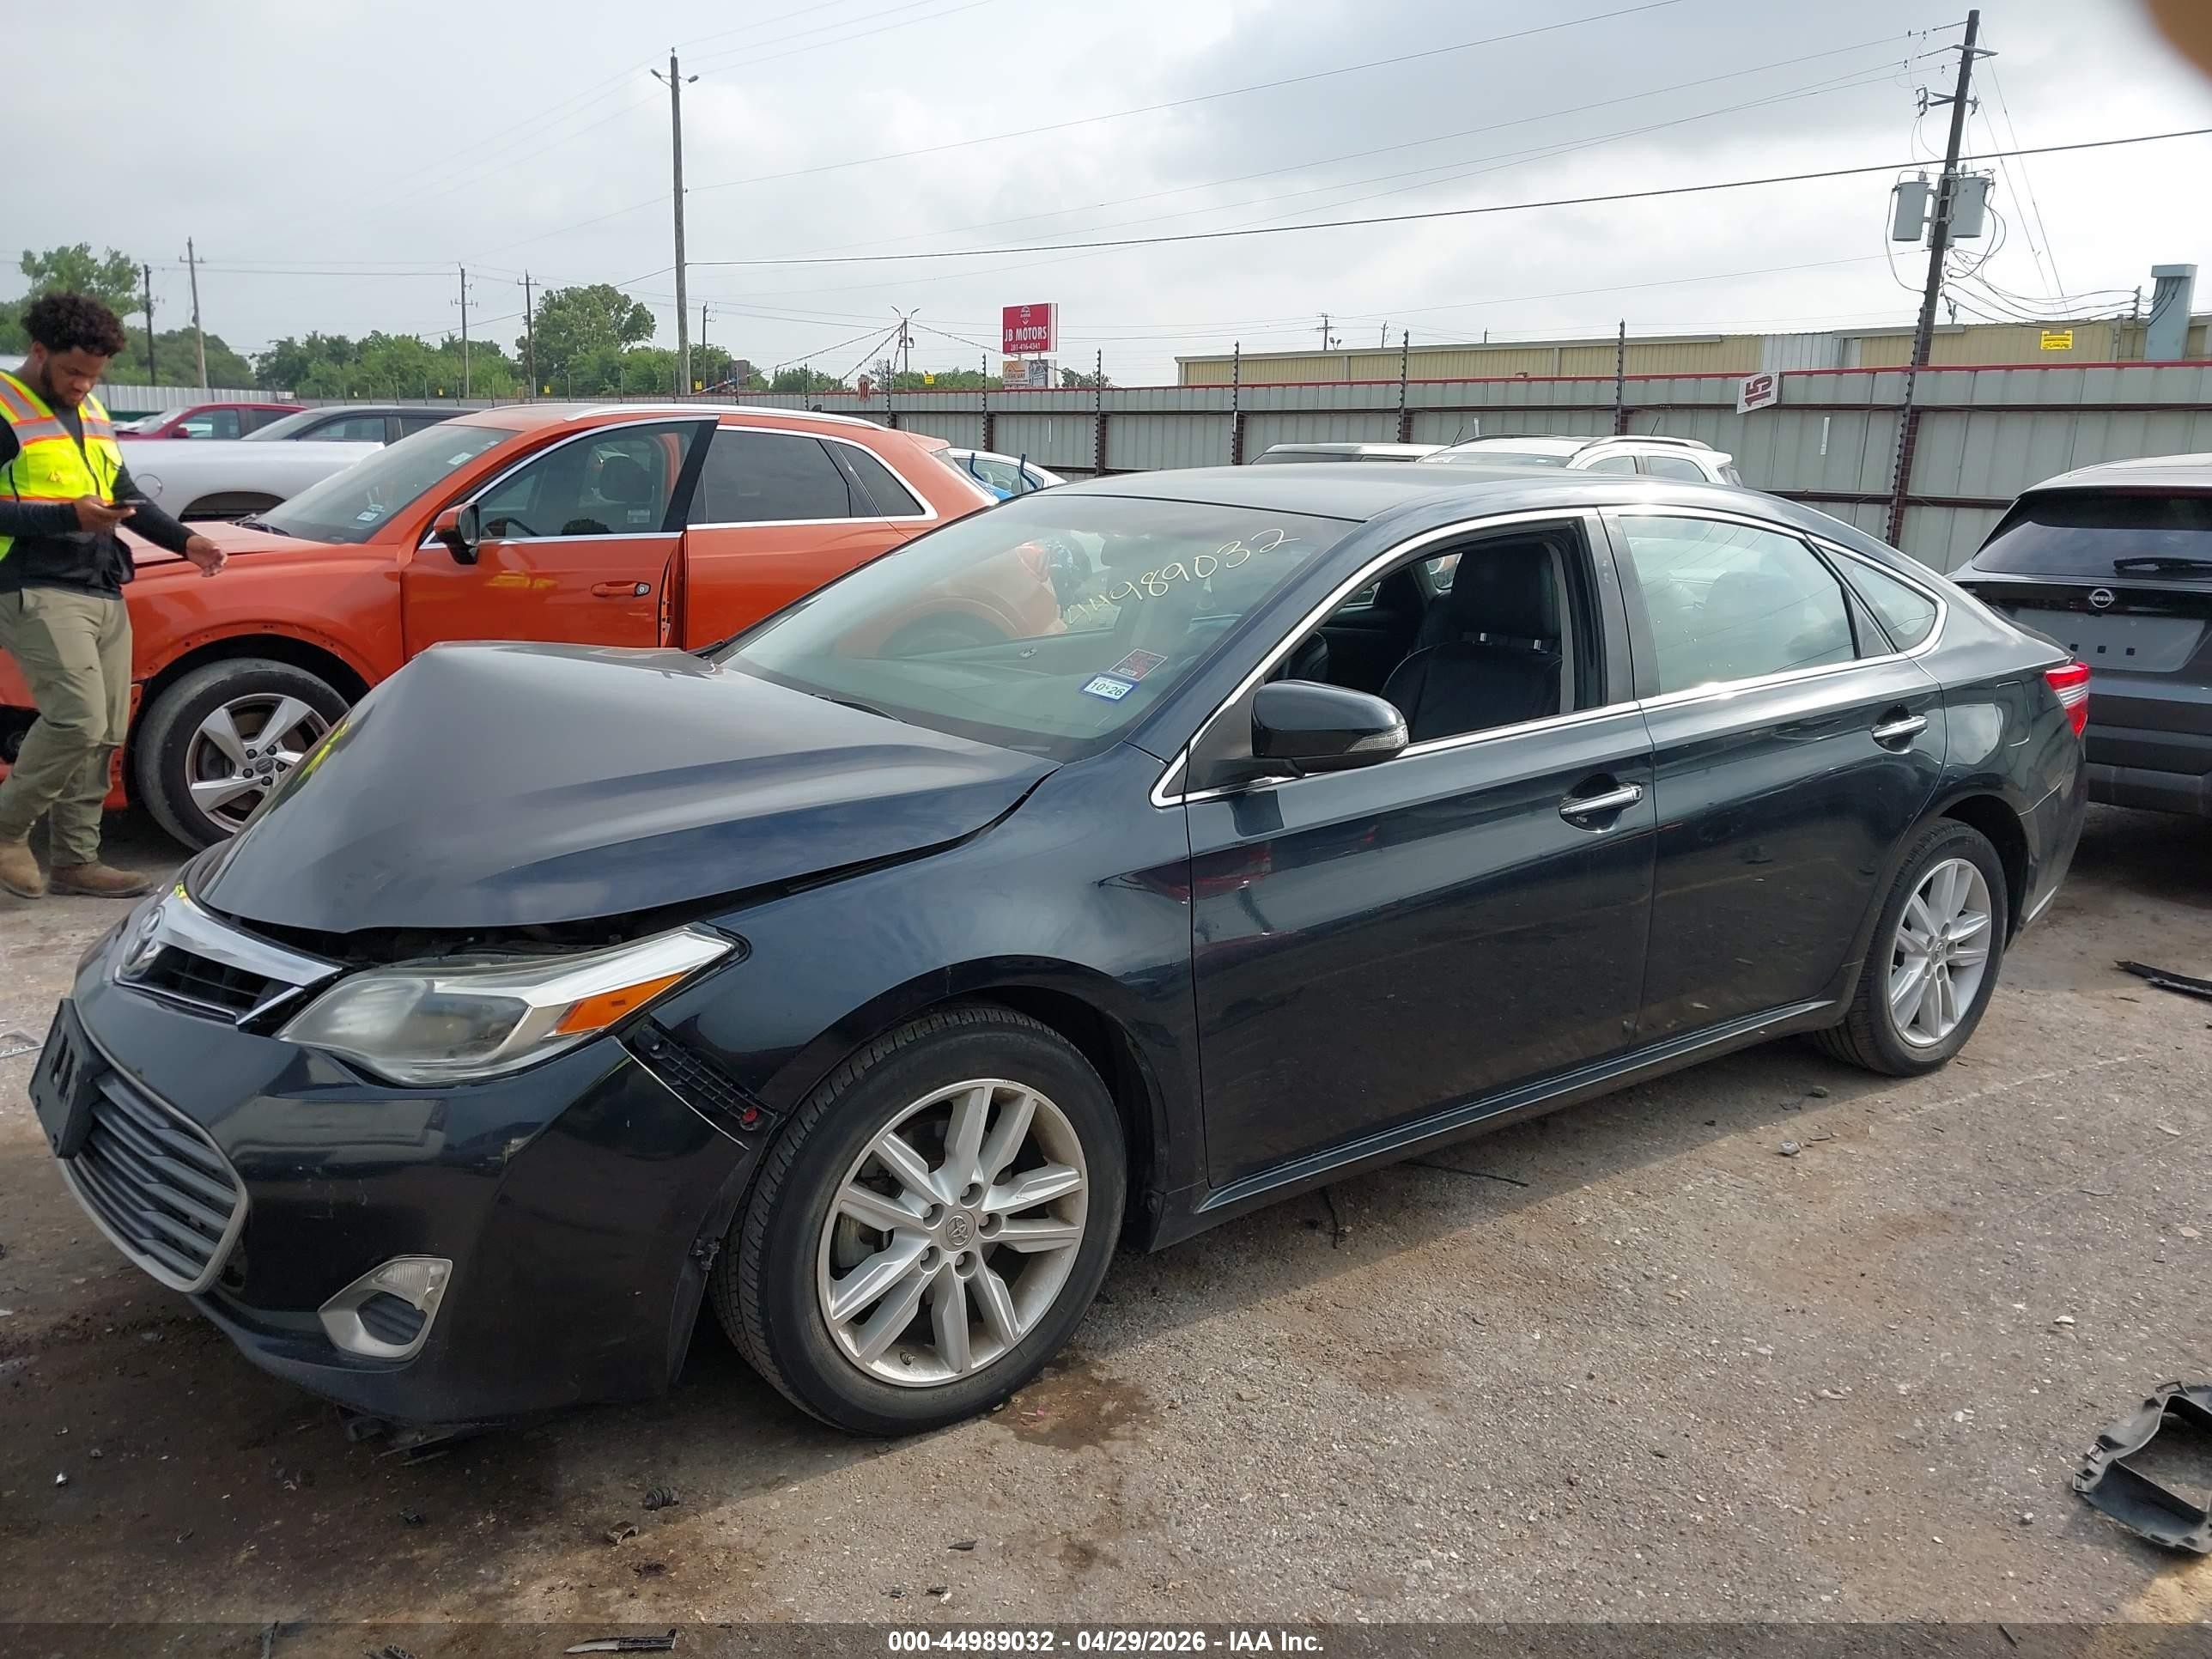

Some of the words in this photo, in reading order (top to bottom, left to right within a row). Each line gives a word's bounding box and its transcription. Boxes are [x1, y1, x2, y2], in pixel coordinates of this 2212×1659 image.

[1005, 328, 1013, 342] JB
[1015, 326, 1047, 341] MOTORS
[1744, 375, 1773, 407] 15
